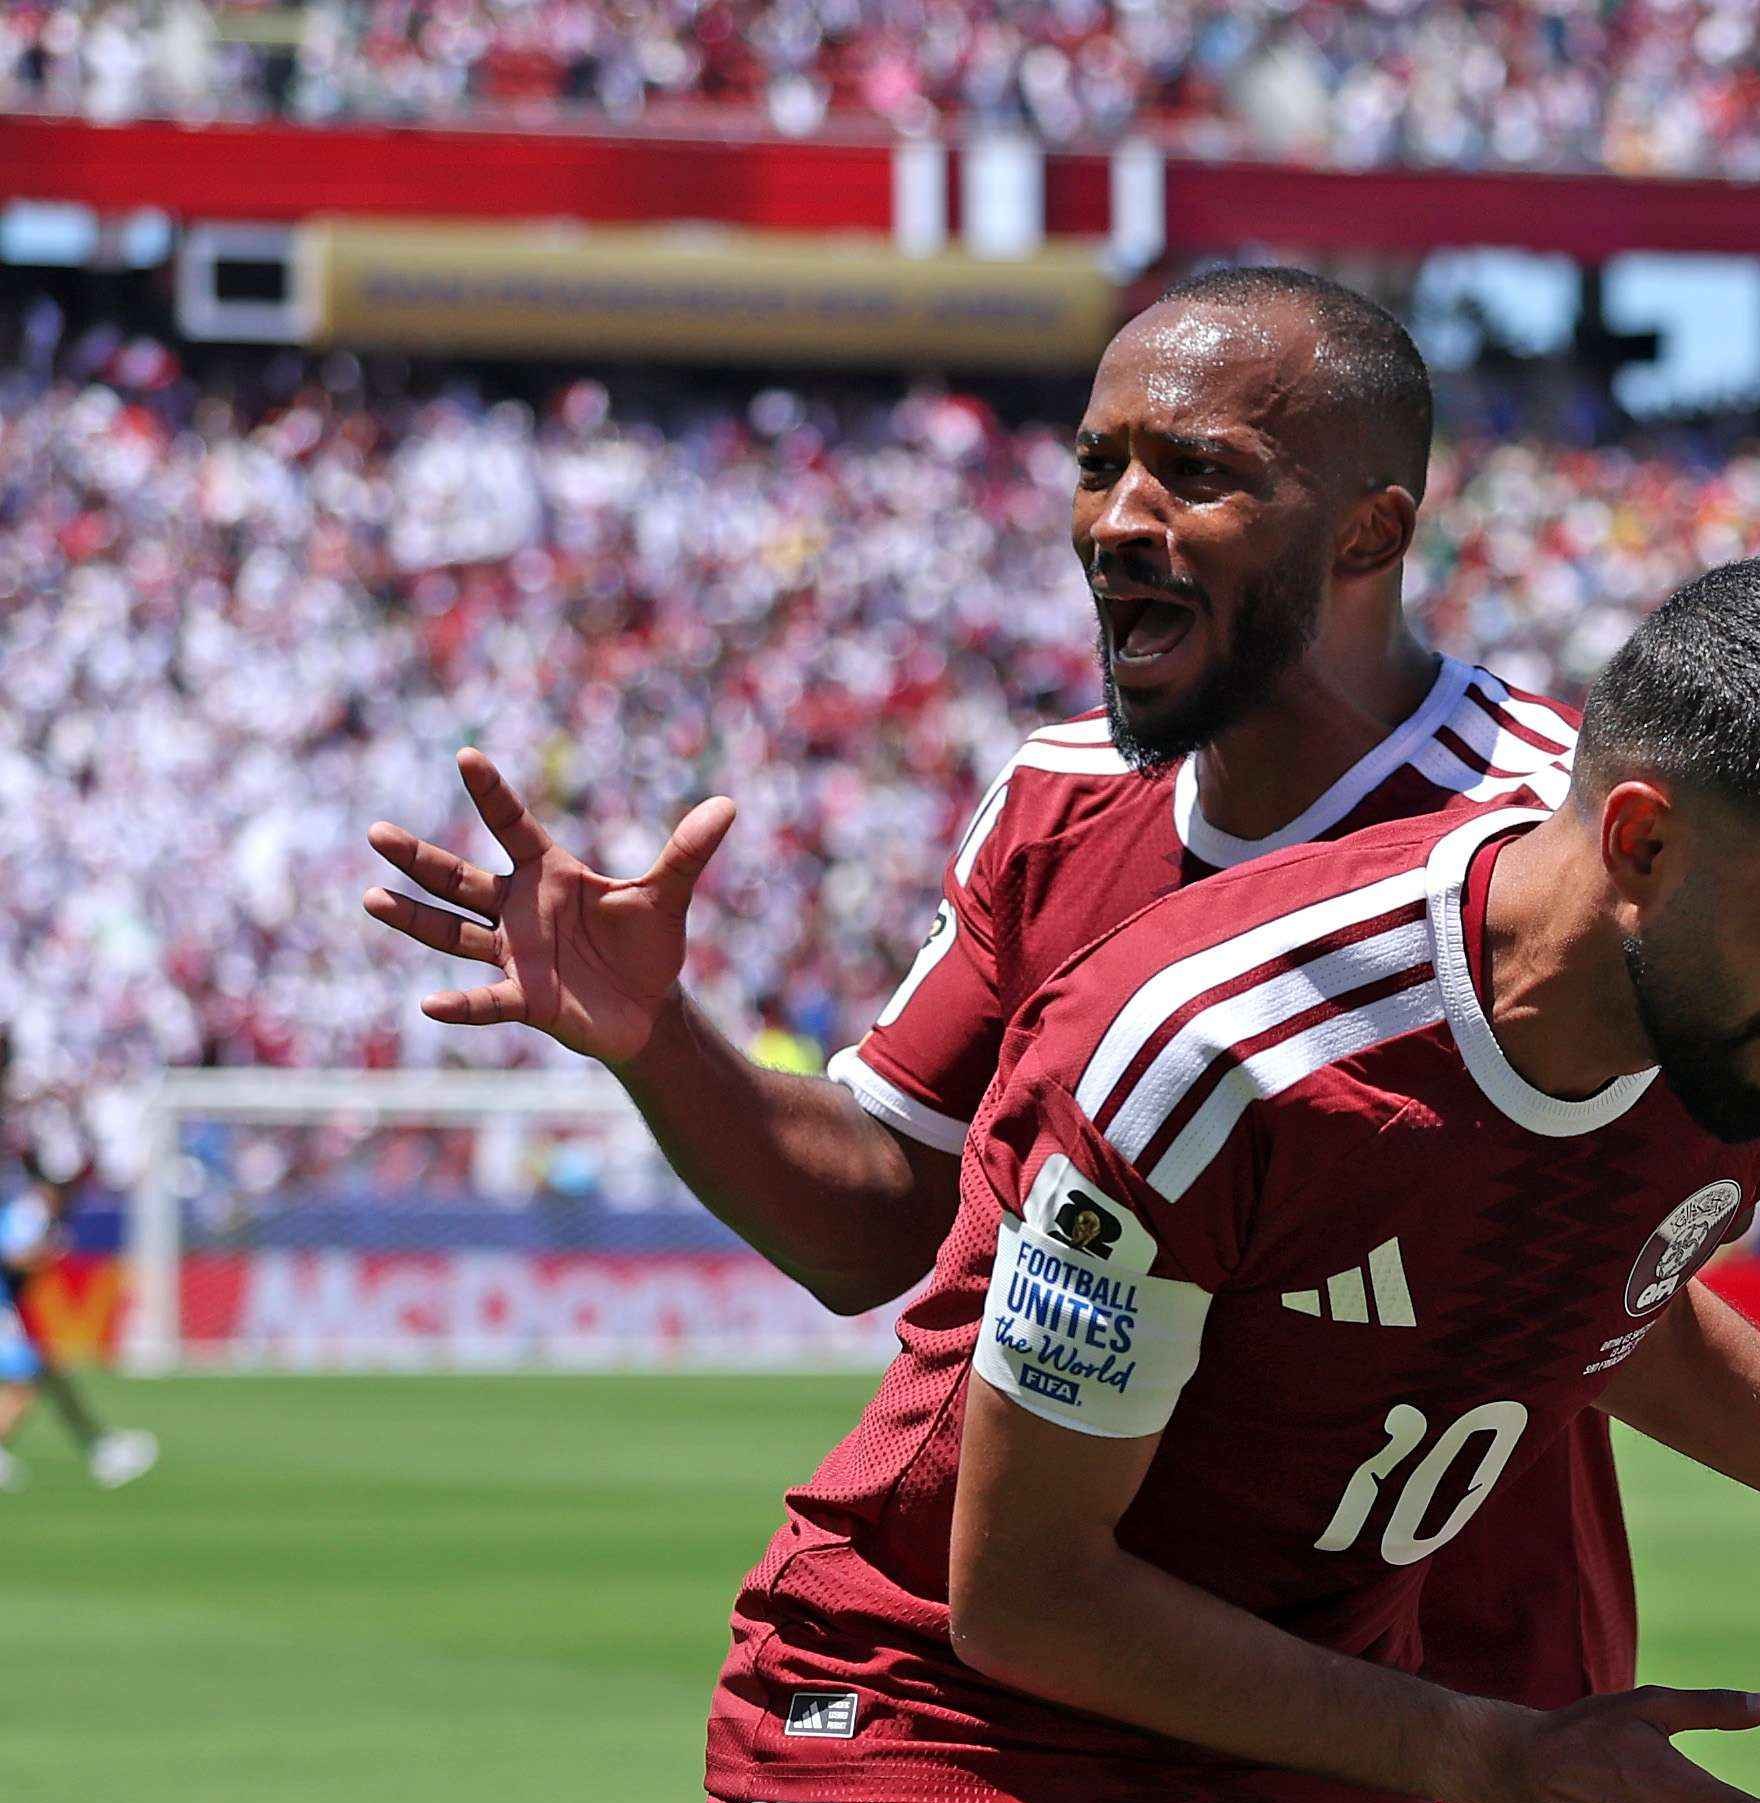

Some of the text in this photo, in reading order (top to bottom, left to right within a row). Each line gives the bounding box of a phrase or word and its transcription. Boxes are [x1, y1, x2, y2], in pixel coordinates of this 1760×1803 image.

[1007, 1271, 1135, 1353] UNITES
[1017, 1241, 1138, 1313] FOOTBALL
[995, 1315, 1136, 1393] the World
[1024, 1366, 1074, 1400] FIFA
[1314, 1401, 1527, 1565] 10
